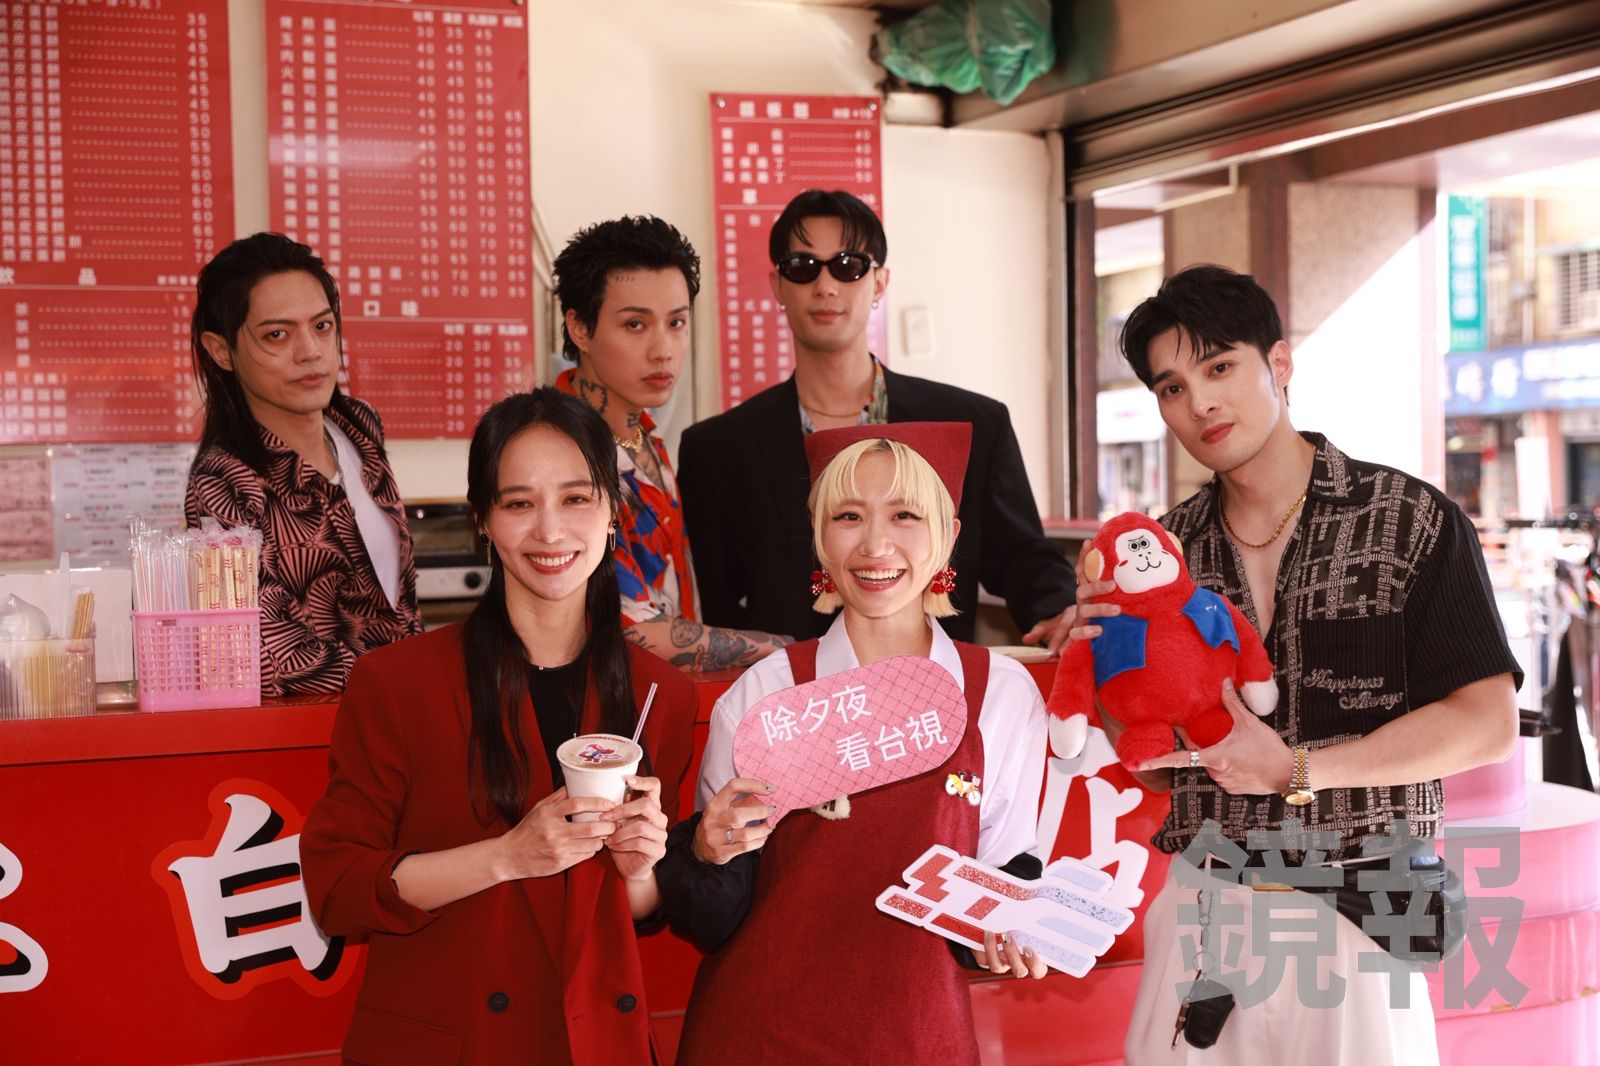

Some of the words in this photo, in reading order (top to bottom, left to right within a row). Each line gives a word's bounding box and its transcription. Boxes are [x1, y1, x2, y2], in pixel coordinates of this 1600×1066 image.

[1303, 668, 1385, 693] Happiness
[1339, 691, 1405, 711] Always
[759, 684, 873, 747] 除夕夜
[836, 709, 949, 773] 看台視
